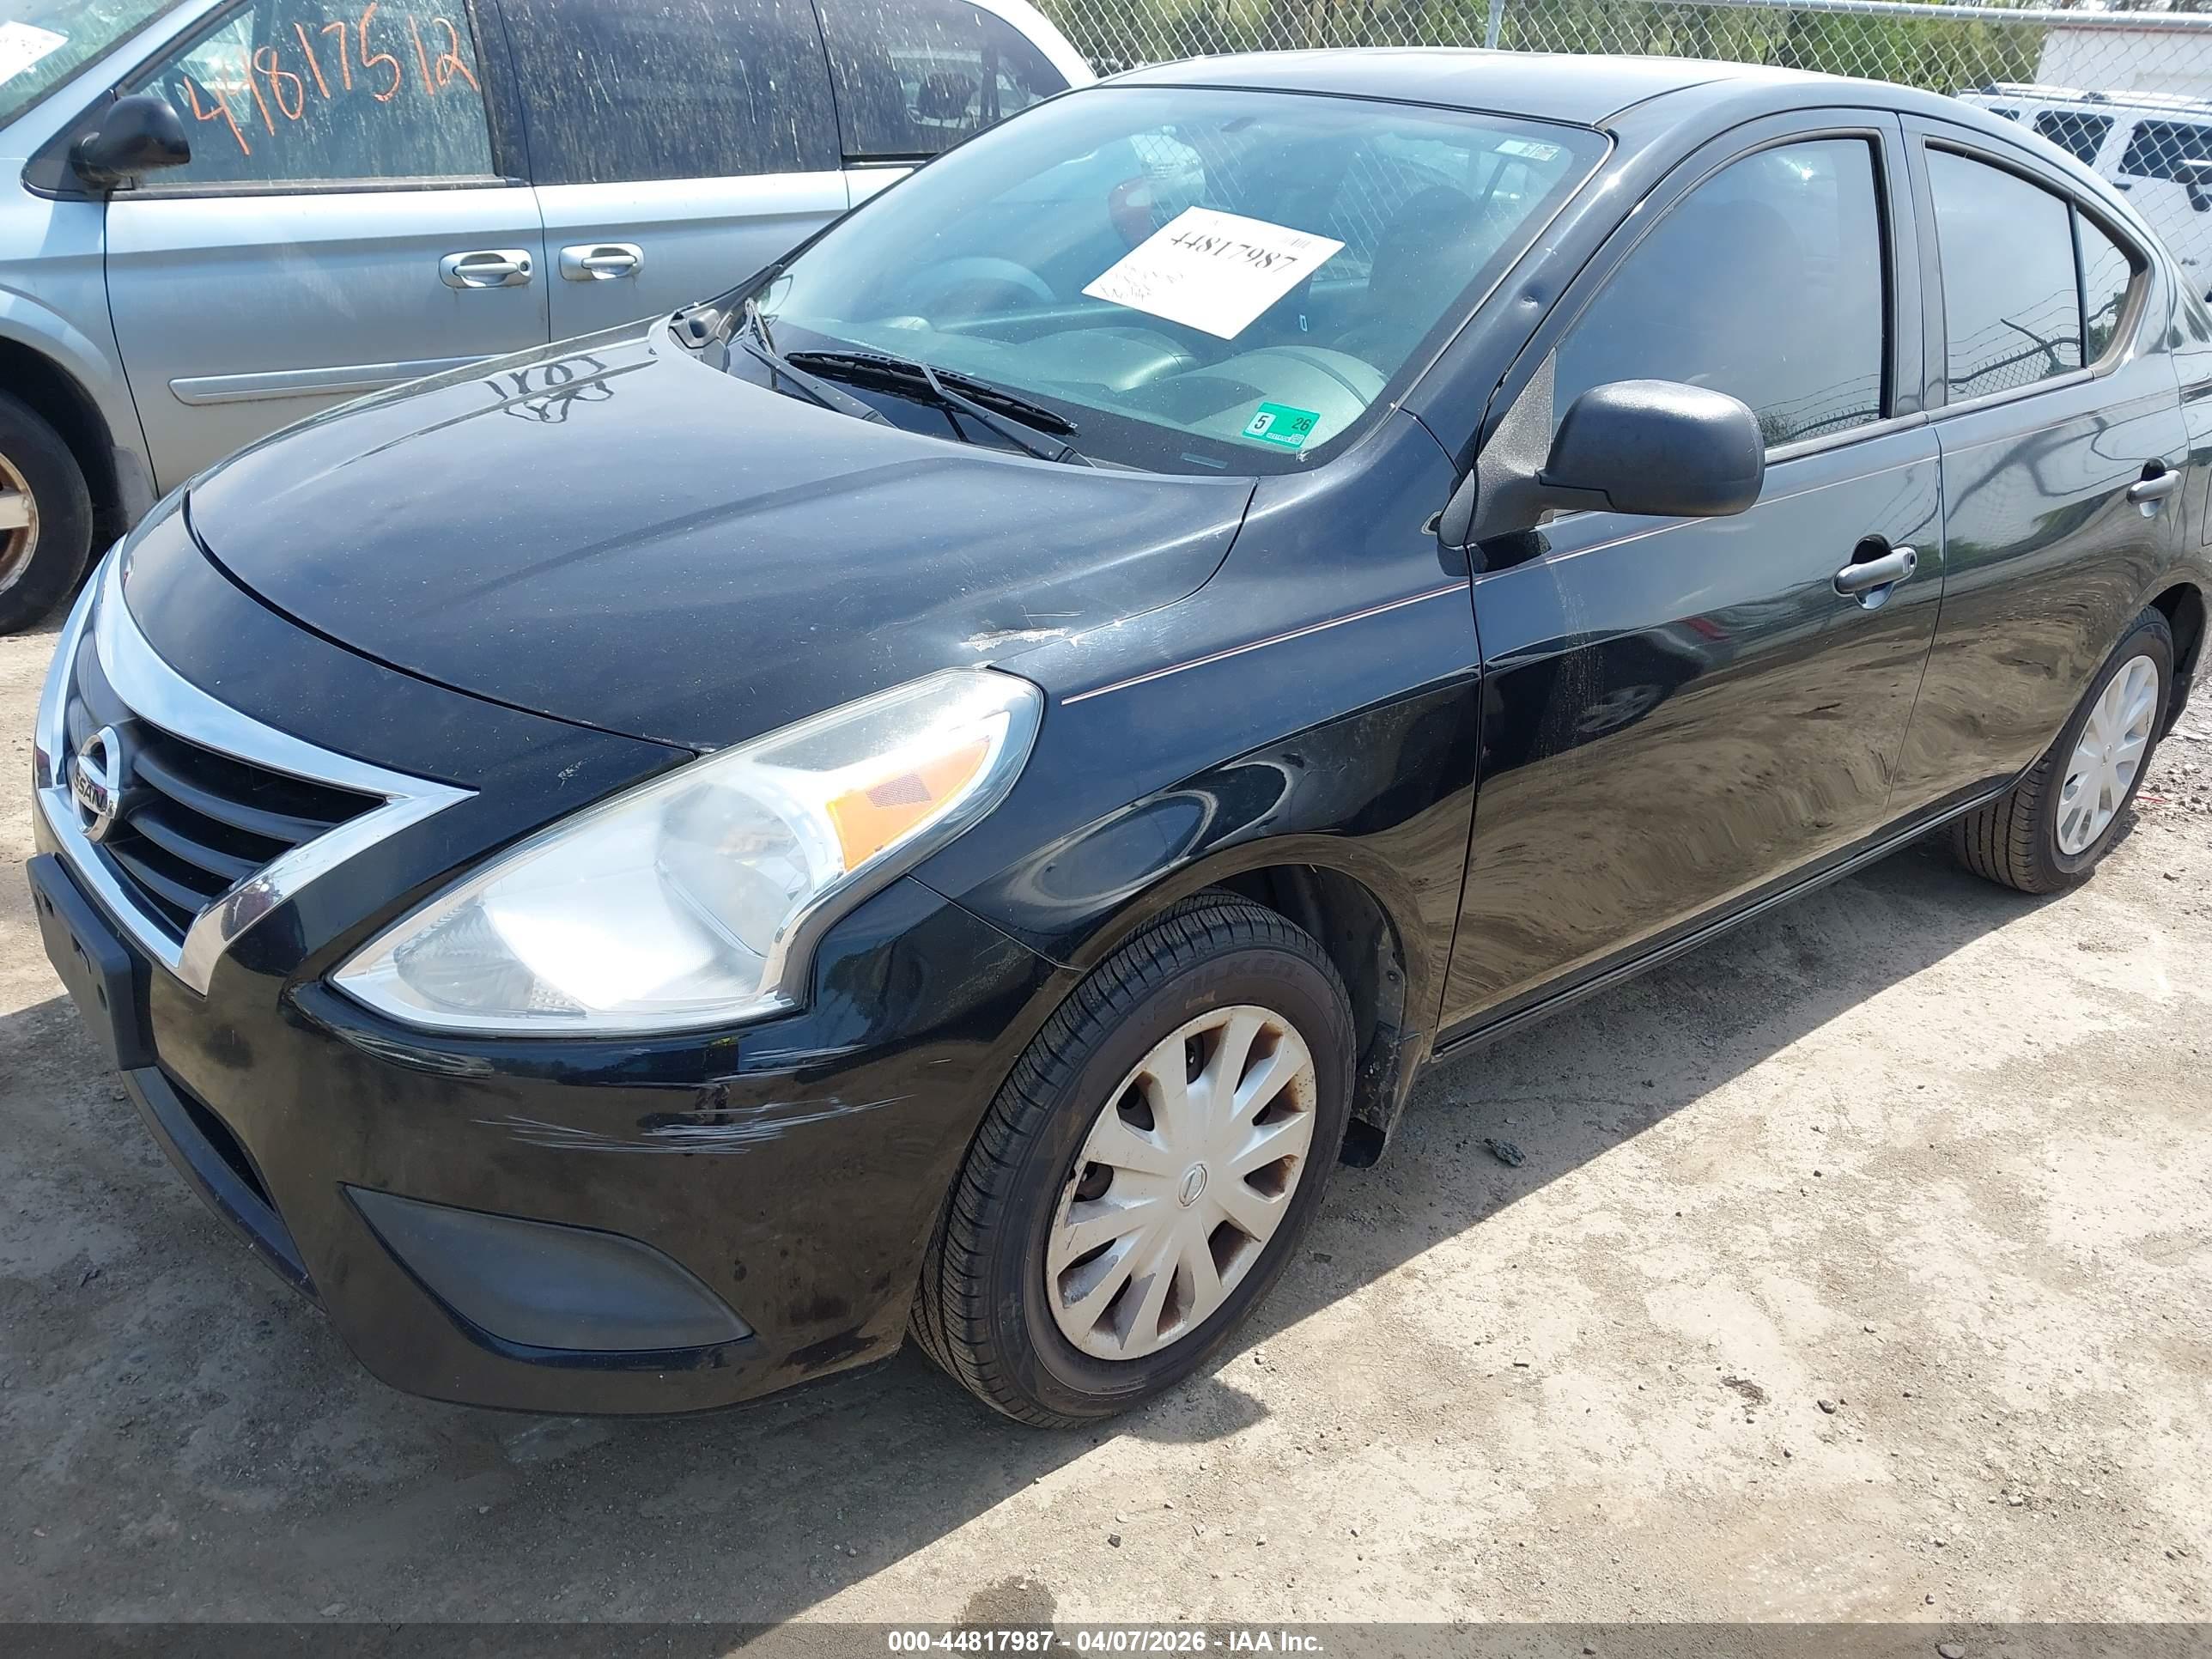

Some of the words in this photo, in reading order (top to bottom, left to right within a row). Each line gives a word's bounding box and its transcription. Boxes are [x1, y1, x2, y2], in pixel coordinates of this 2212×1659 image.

[182, 2, 480, 156] 44817512
[1170, 231, 1299, 273] 44817987
[1254, 415, 1270, 429] 5
[1291, 416, 1313, 432] 26
